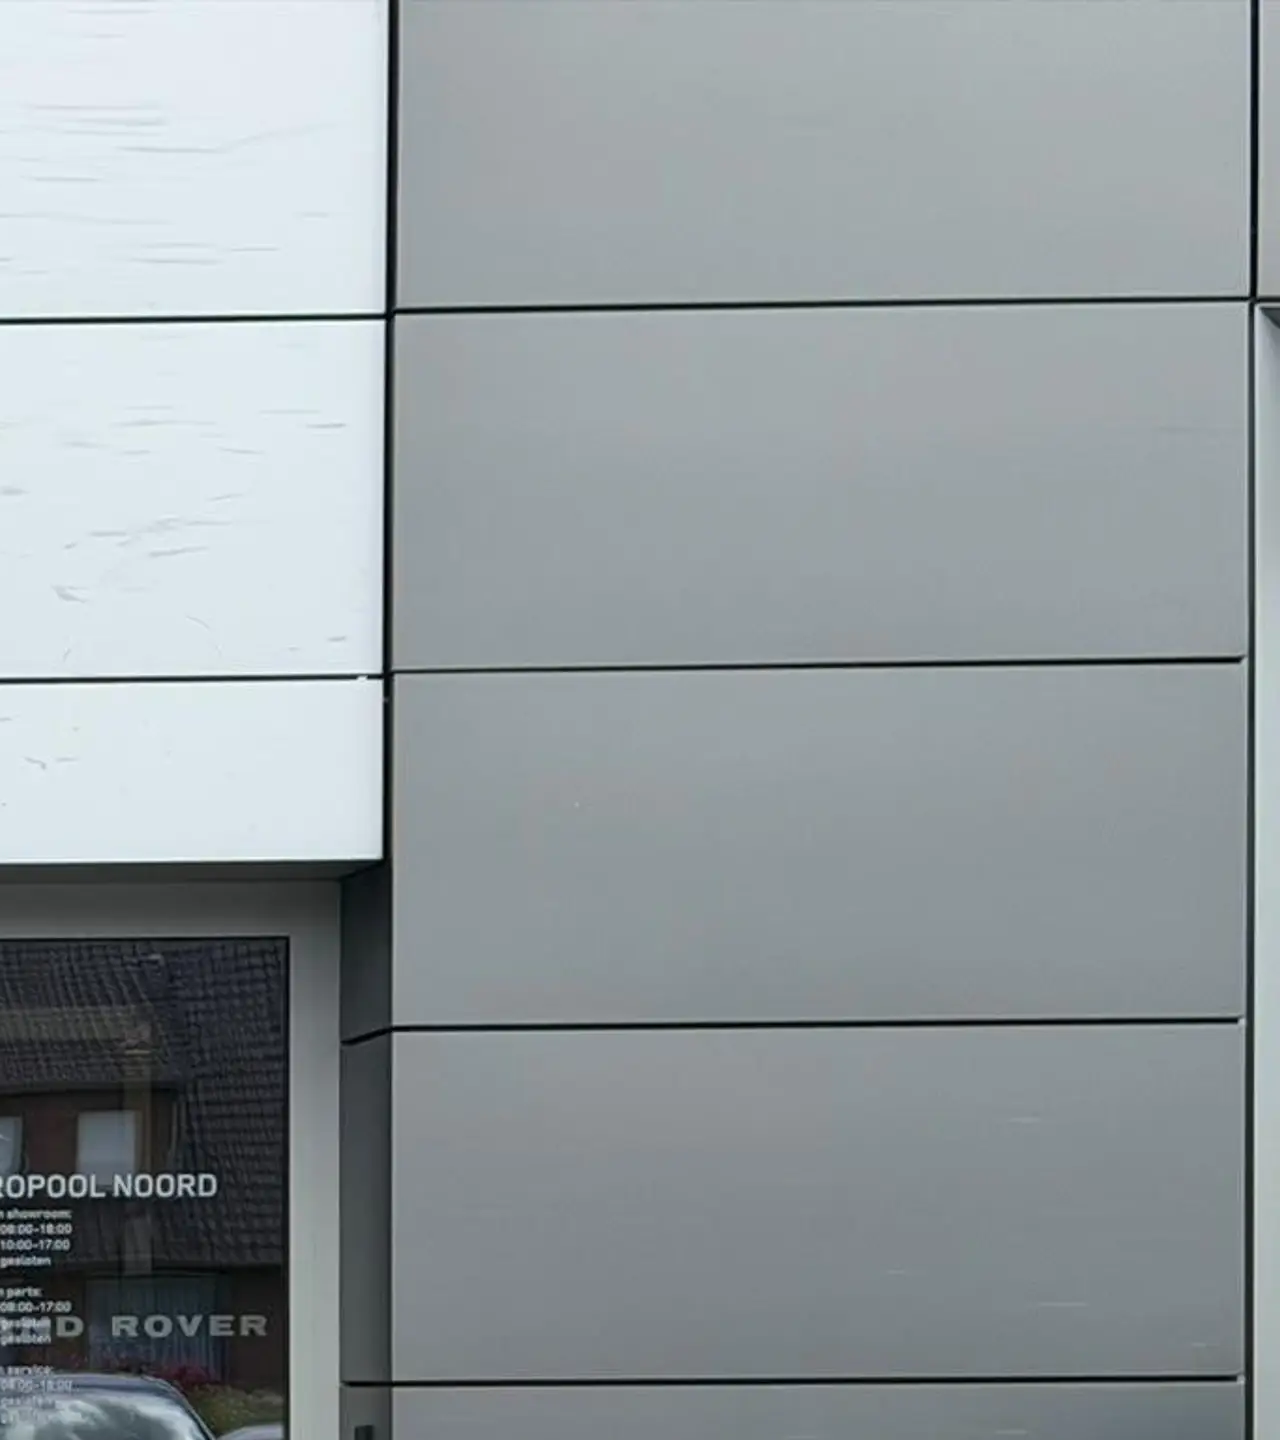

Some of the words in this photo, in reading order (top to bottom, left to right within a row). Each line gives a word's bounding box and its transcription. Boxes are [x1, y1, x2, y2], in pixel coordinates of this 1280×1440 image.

[113, 1172, 217, 1198] NOORD
[0, 1239, 71, 1250] 10:00-17:00
[0, 1255, 51, 1269] gesloten
[0, 1301, 72, 1313] 08:00-17:00
[111, 1314, 268, 1338] ROVER
